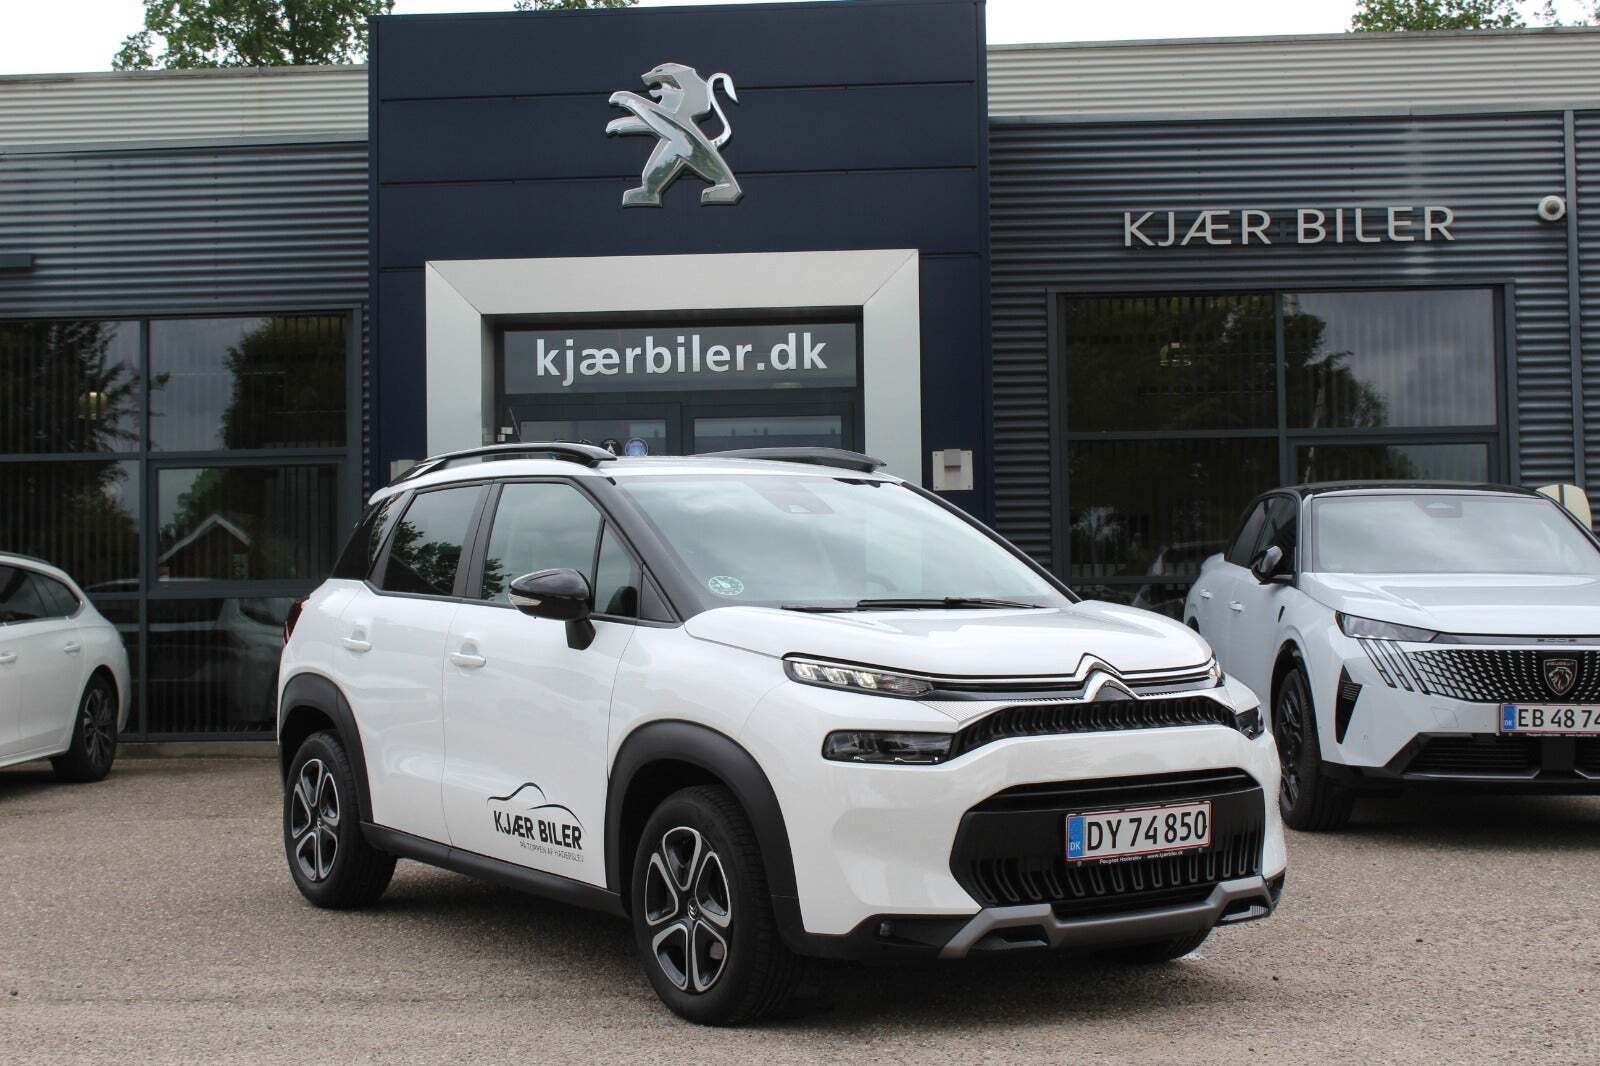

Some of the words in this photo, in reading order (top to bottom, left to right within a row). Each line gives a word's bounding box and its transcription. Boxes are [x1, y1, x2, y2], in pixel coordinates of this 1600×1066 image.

[1123, 209, 1272, 247] KJÆR
[1297, 206, 1456, 244] BILER
[536, 332, 828, 387] kjærbiler.dk
[1518, 708, 1545, 728] EB
[1550, 708, 1576, 729] 48
[493, 810, 536, 841] KJÆR
[538, 819, 583, 850] BILER
[1070, 841, 1081, 850] DK
[1087, 819, 1122, 851] DY
[1129, 815, 1158, 847] 74
[1164, 810, 1207, 843] 850
